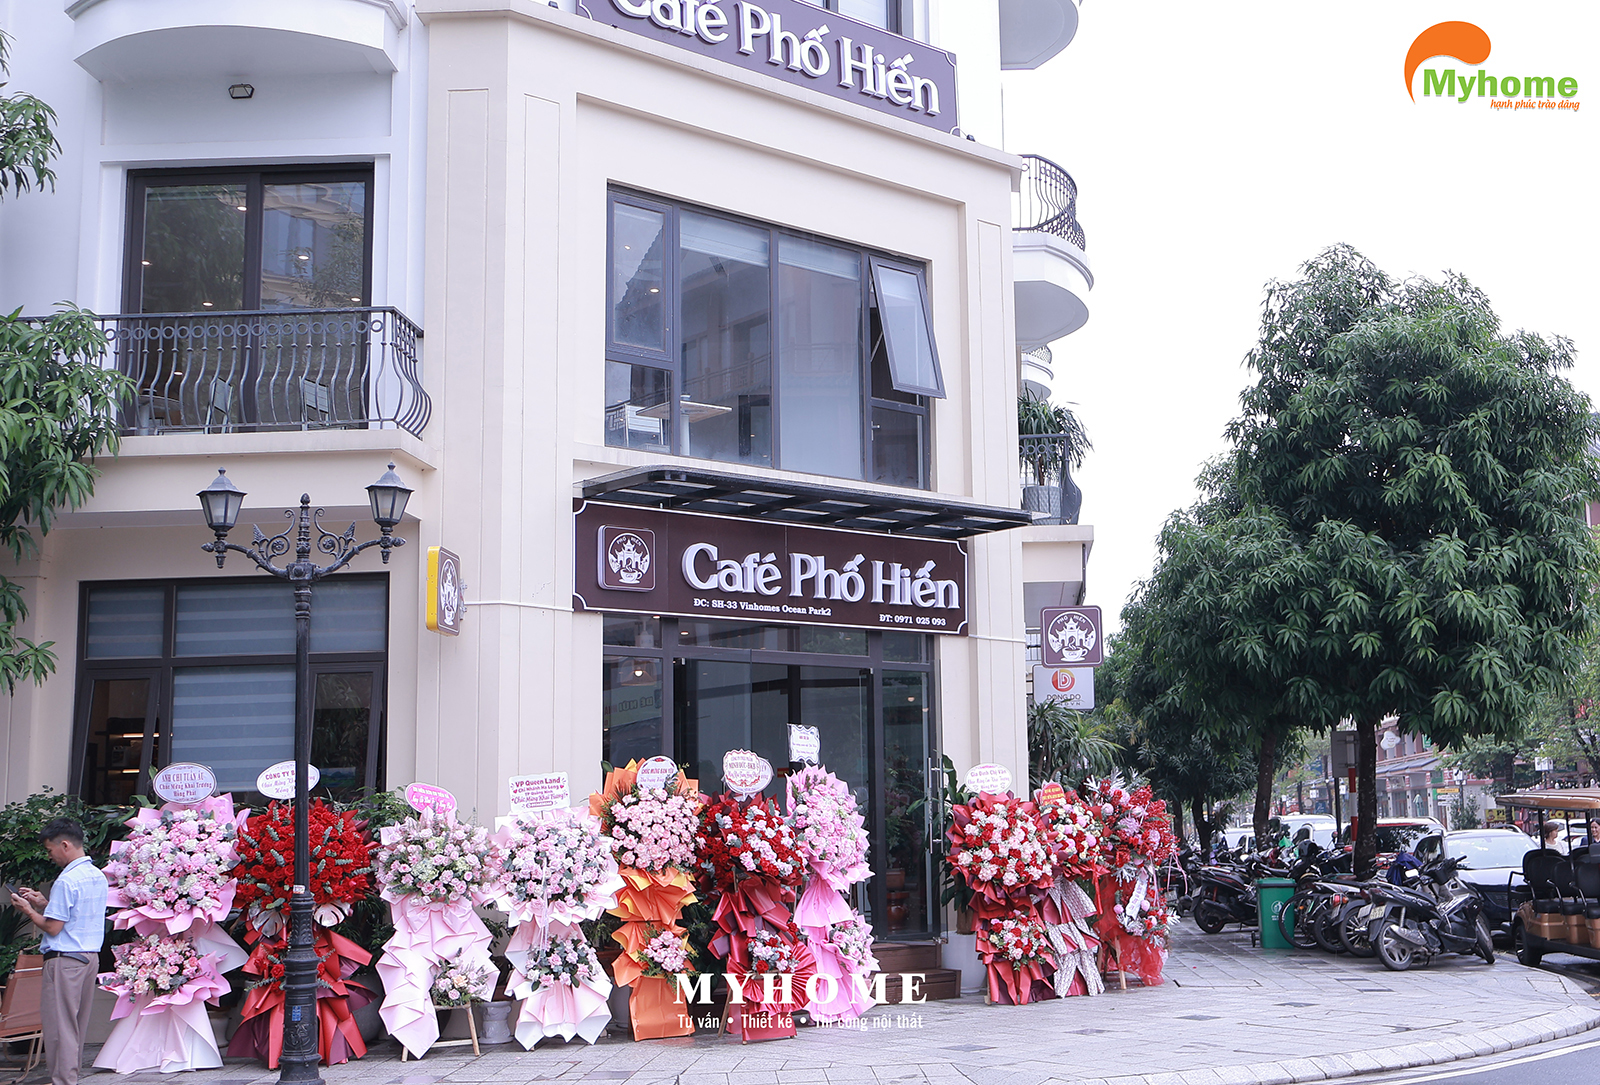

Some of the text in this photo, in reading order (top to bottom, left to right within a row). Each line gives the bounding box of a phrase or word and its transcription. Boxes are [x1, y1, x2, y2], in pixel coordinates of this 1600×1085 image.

[738, 1, 831, 77] Phố
[836, 36, 942, 116] Hiến
[682, 543, 961, 610] Café Phố Hiến
[693, 598, 832, 616] ĐC: SH-33 Vinhomes Ocean Park2
[879, 614, 947, 626] ĐT: 0971 025 093
[515, 776, 561, 788] VP Queen Land
